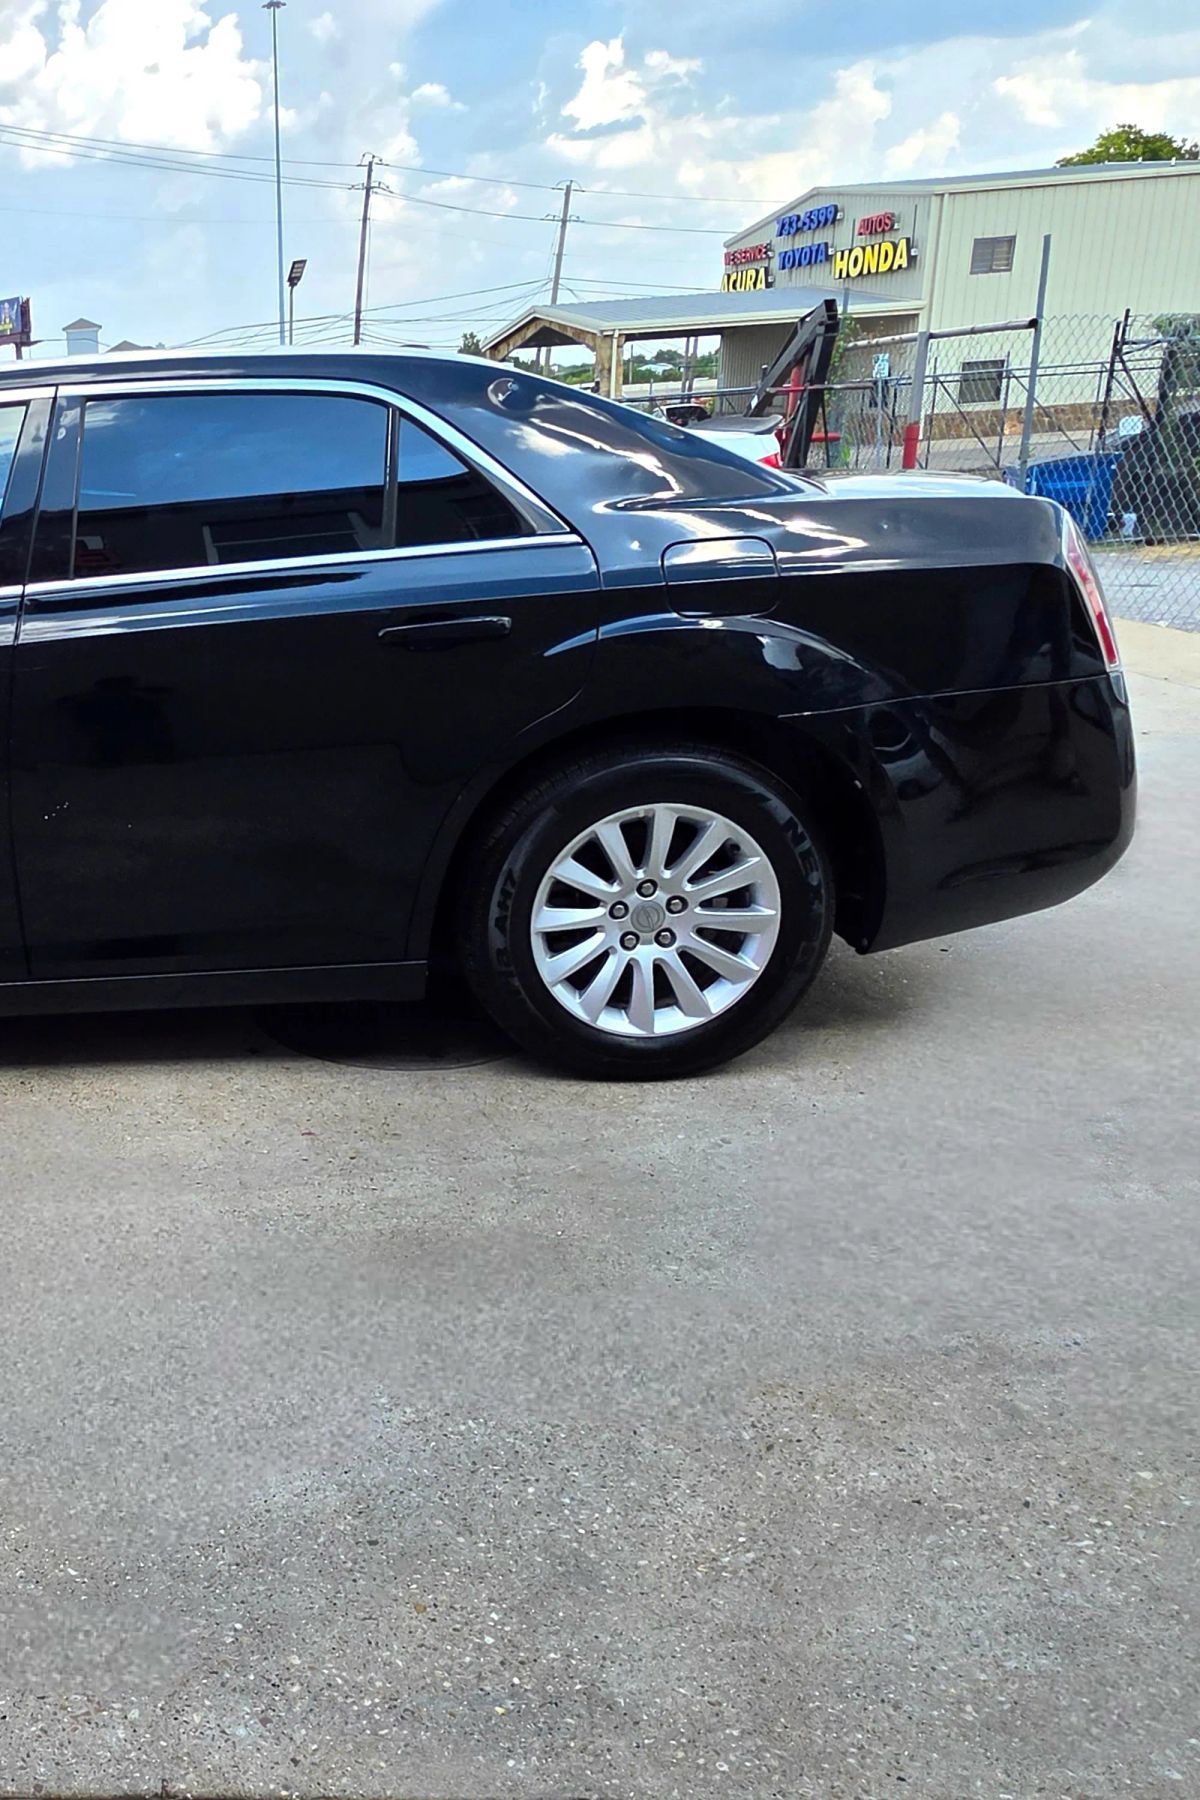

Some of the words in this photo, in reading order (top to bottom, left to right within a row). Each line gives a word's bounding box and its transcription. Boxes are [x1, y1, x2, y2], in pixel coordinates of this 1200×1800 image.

[779, 243, 826, 270] TOYOTA
[834, 238, 907, 279] HONDA
[721, 267, 766, 293] ACURA
